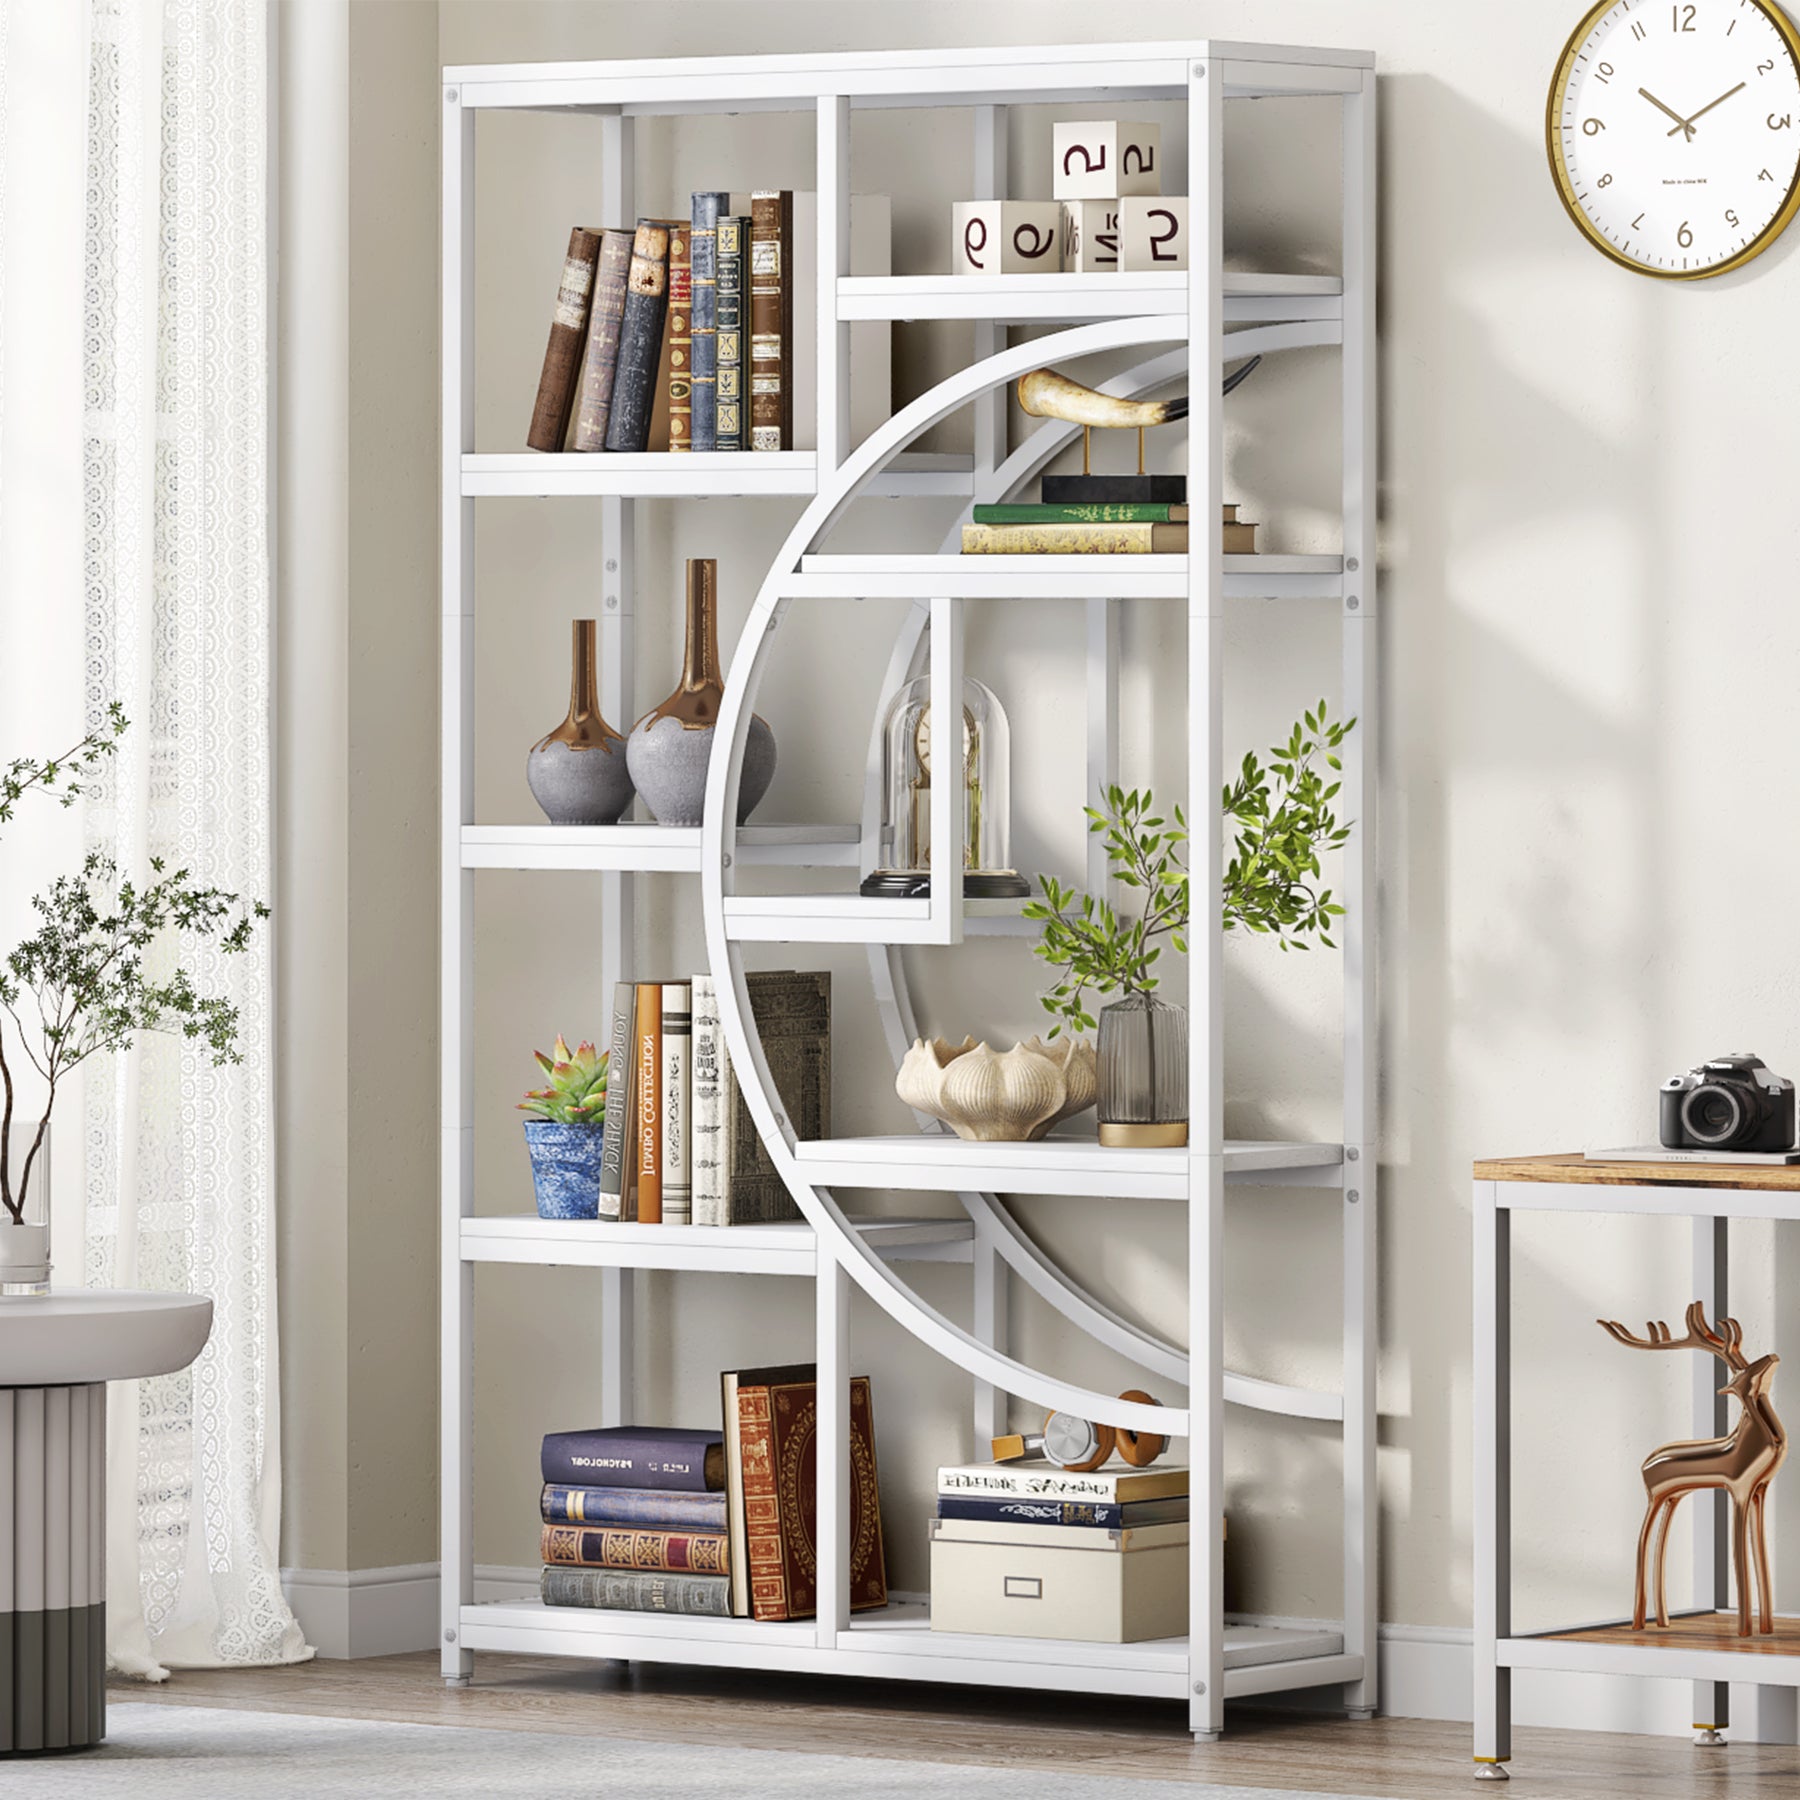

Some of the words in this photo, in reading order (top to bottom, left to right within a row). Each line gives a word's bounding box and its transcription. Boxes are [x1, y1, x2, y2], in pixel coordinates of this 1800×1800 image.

[1673, 5, 1696, 32] 12
[1726, 19, 1736, 36] 1
[1631, 21, 1647, 41] 11
[1594, 61, 1614, 84] 10
[1756, 59, 1774, 76] 2
[1582, 117, 1606, 137] 9
[1767, 113, 1791, 131] 3
[1597, 173, 1613, 189] 8
[1756, 168, 1774, 183] 4
[1631, 212, 1646, 231] 7
[1724, 209, 1739, 228] 5
[1677, 221, 1693, 248] 6
